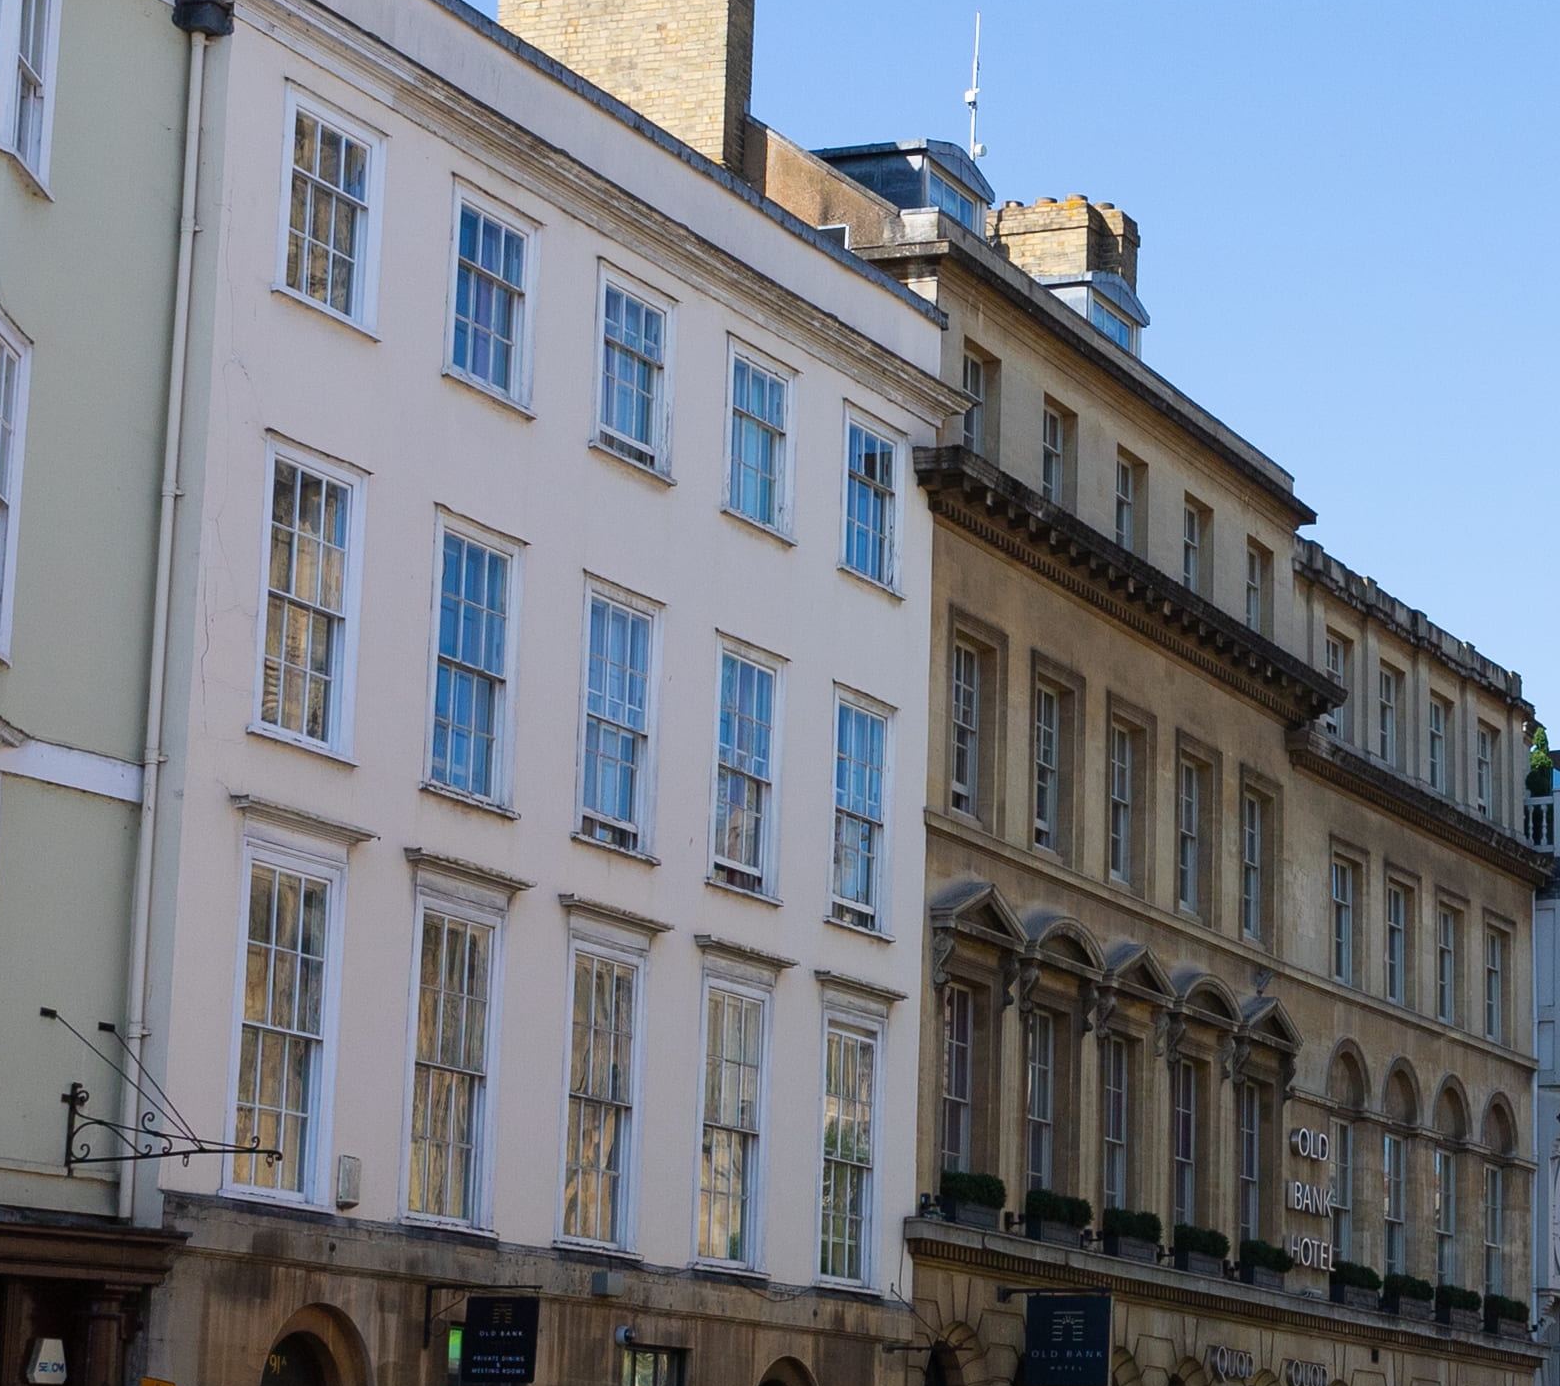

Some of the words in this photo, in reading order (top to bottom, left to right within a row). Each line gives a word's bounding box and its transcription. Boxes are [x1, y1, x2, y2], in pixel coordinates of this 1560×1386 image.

[1298, 1128, 1329, 1161] OLD
[1294, 1182, 1333, 1217] BANK
[1291, 1235, 1336, 1272] HOTEL
[1031, 1350, 1058, 1358] OLD
[1066, 1350, 1103, 1358] BANK
[1217, 1346, 1254, 1382] QUOD
